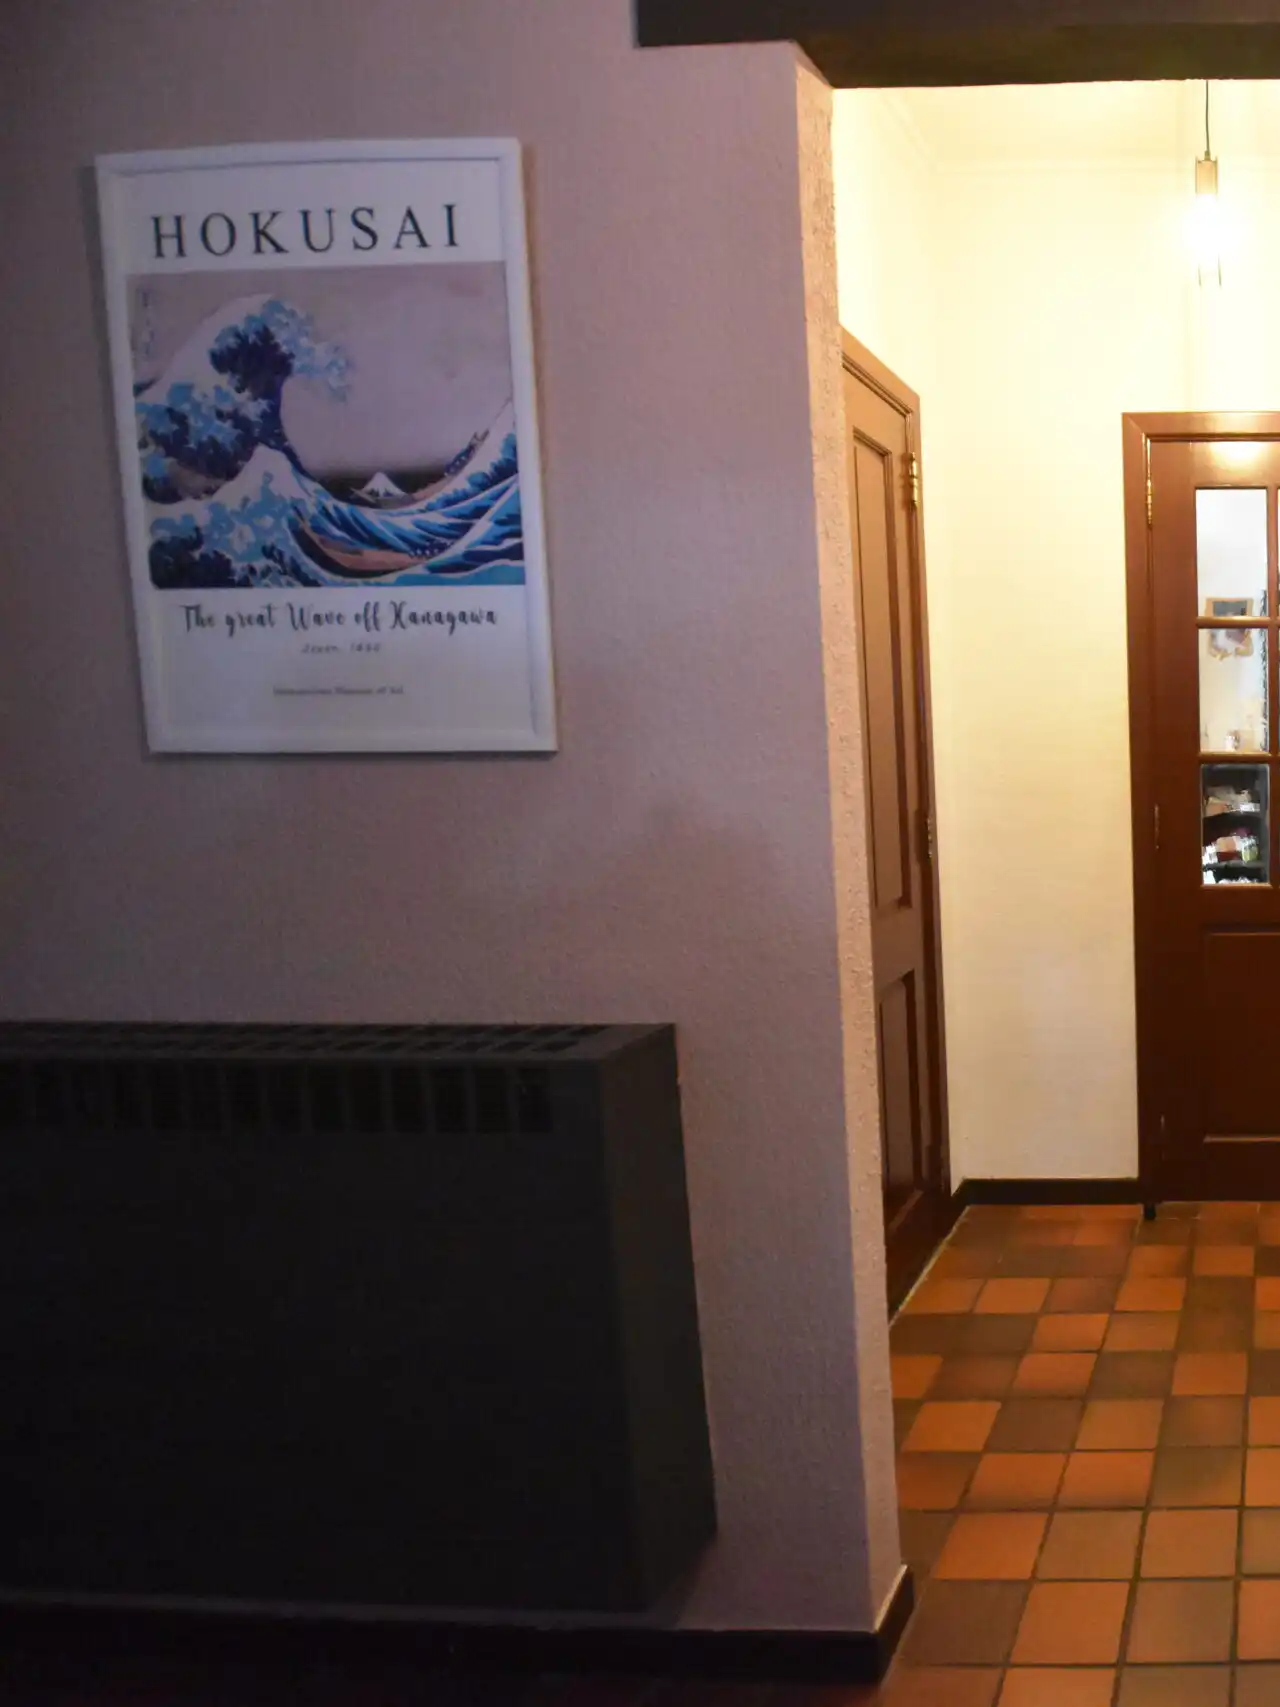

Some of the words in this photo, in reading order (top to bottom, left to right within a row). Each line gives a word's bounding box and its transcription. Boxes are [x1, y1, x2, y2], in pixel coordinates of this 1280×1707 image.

[151, 203, 459, 259] HOKUSAI
[181, 604, 215, 633] The
[225, 603, 279, 637] great
[286, 602, 346, 631] Wave
[354, 601, 382, 632] off
[389, 600, 498, 636] Kanagawa
